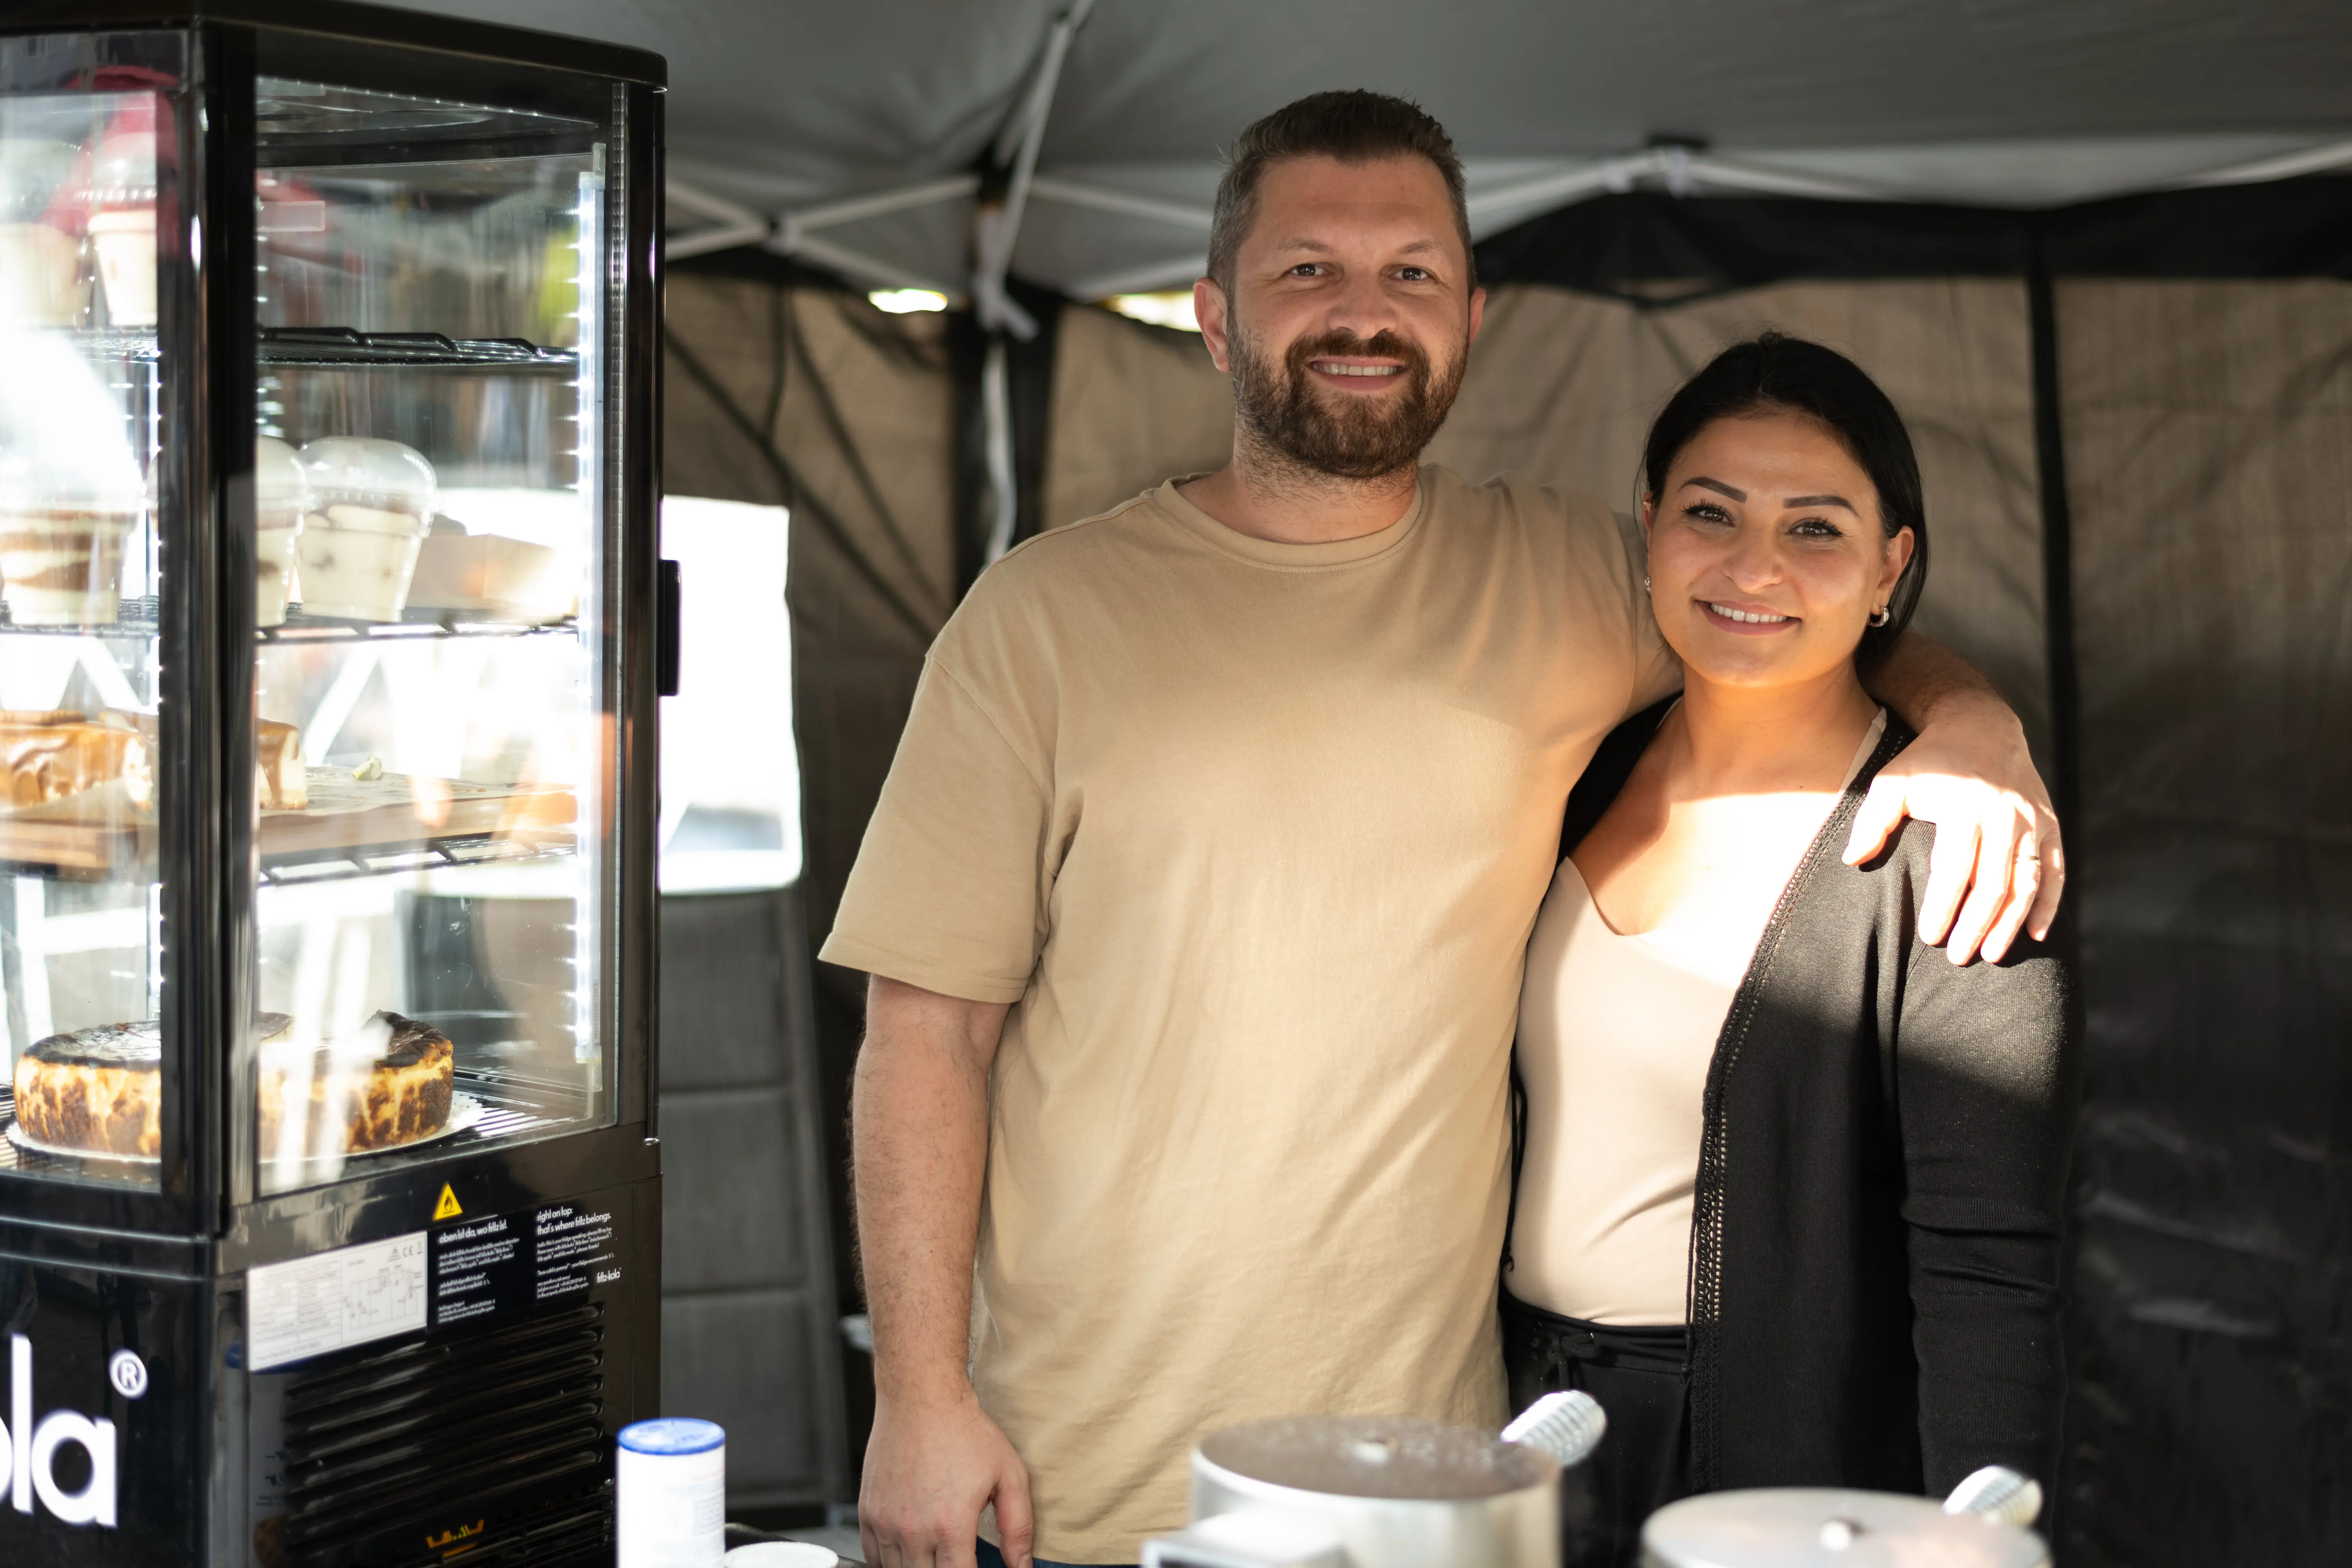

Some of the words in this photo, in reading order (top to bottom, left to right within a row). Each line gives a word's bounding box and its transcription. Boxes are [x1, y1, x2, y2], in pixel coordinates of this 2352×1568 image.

[537, 1209, 551, 1223] right
[561, 1206, 573, 1217] top:
[537, 1222, 554, 1235] that's
[555, 1220, 575, 1231] where
[575, 1216, 586, 1227] fritz
[586, 1212, 612, 1223] belongs.
[439, 1231, 457, 1243] oben
[465, 1227, 476, 1238] da,
[477, 1227, 488, 1235] wo
[488, 1221, 499, 1233] fritz
[500, 1218, 508, 1230] ist.
